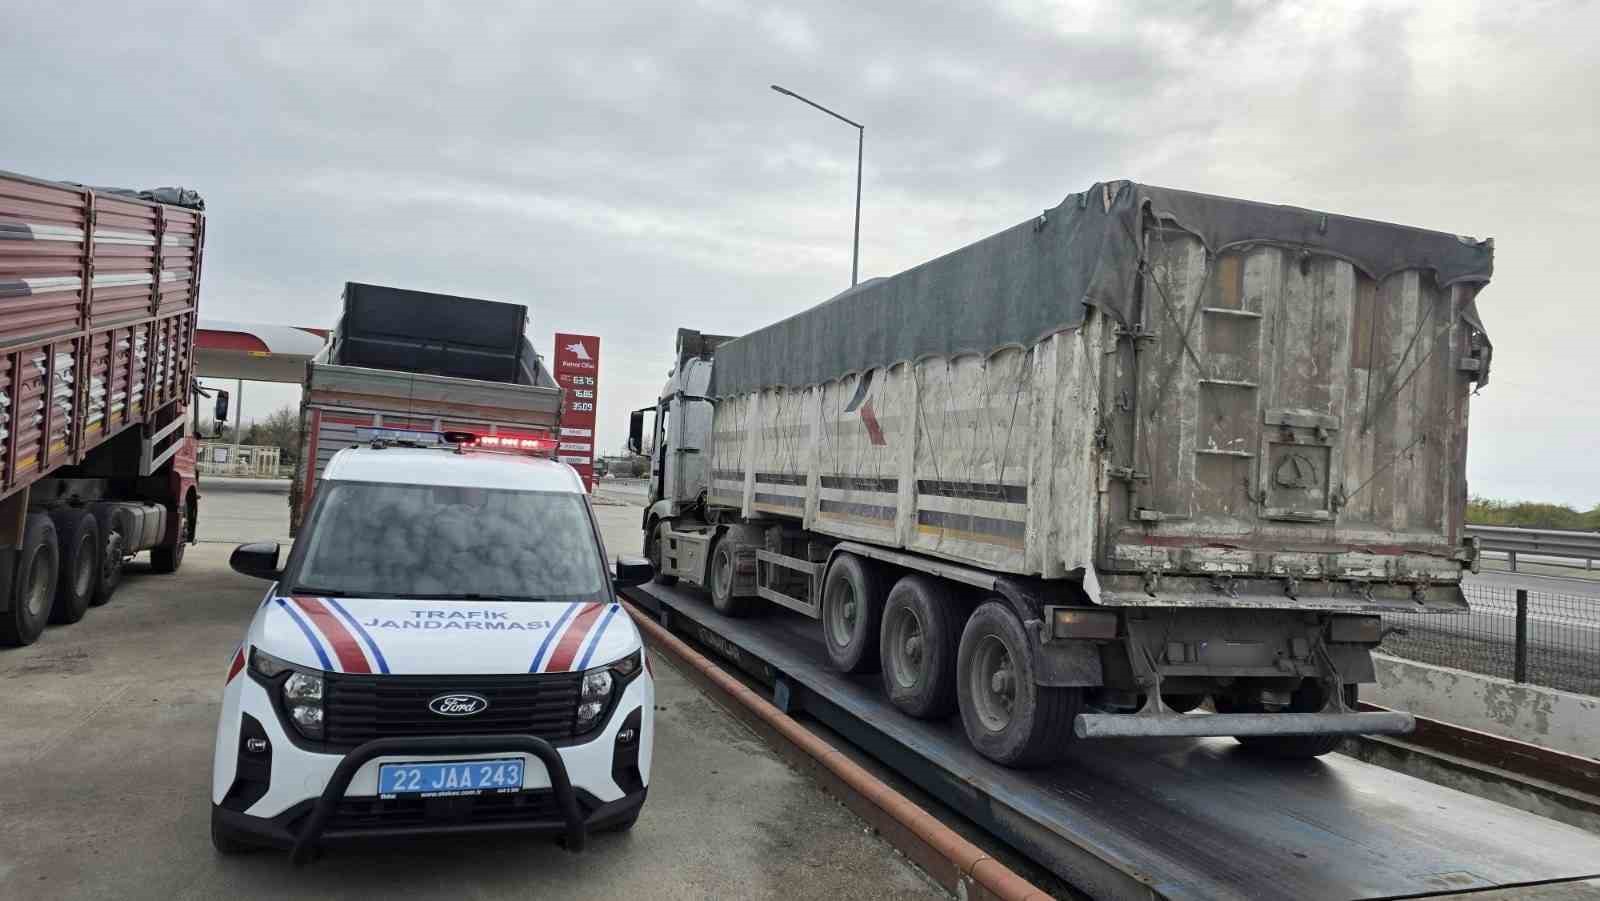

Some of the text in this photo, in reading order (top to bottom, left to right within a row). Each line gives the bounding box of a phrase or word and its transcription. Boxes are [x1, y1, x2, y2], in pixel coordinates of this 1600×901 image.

[412, 610, 508, 619] TRAFİK
[364, 618, 551, 630] JANDARMASI
[440, 698, 478, 712] Ford
[393, 765, 519, 791] 22 JAA 243
